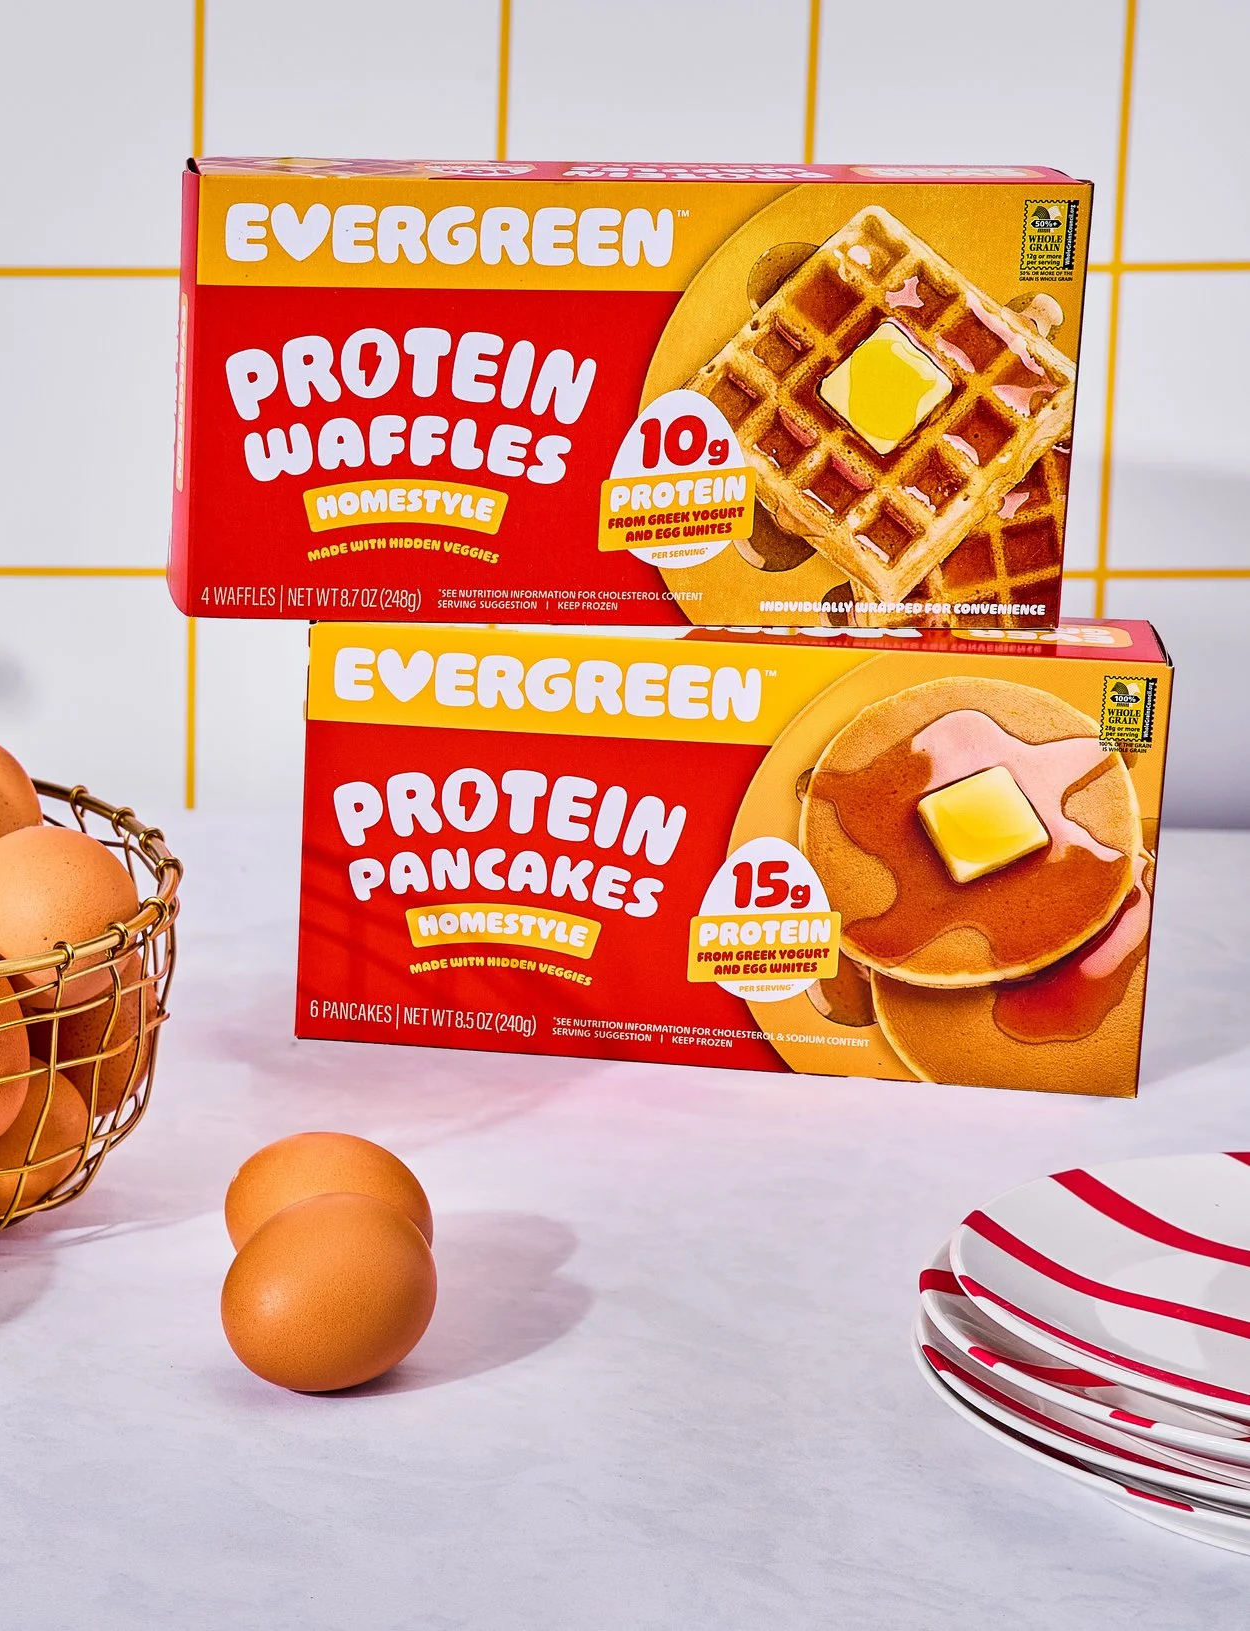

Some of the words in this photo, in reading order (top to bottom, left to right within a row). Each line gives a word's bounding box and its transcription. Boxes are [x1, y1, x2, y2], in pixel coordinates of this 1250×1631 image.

[226, 203, 673, 266] EVERGREEN
[1028, 235, 1063, 243] WHOLE
[225, 327, 597, 425] PROTEIN
[244, 414, 572, 484] WAFFLES
[640, 415, 730, 469] 10g
[317, 489, 495, 521] HOMESTYLE
[610, 475, 746, 512] PROTEIN
[608, 516, 645, 529] FROM
[648, 512, 689, 525] GREEK
[692, 507, 744, 521] YOGURT
[626, 530, 652, 542] AND
[656, 527, 680, 539] EGG
[682, 522, 732, 537] WHITES
[308, 543, 348, 561] MADE
[350, 538, 386, 551] WITH
[390, 538, 440, 550] HIDDEN
[444, 542, 499, 563] VEGGIES
[651, 550, 668, 559] PER
[201, 587, 209, 604] 4
[214, 587, 275, 606] WAFFLES
[288, 588, 313, 606] NET
[316, 588, 339, 606] WT
[341, 589, 359, 607] 8.7
[361, 589, 377, 607] OZ
[380, 588, 421, 612] (248g)
[438, 600, 476, 608] SERVING
[480, 601, 537, 609] SUGGESTION
[582, 602, 617, 610] FROZEN
[459, 590, 508, 598] NUTRITION
[511, 590, 576, 599] INFORMATION
[578, 591, 596, 599] FOR
[598, 591, 659, 600] CHOLESTEROL
[662, 591, 703, 601] CONTENT
[759, 601, 853, 613] INDIVIDUALLY
[855, 602, 922, 614] WRAPPED
[924, 603, 952, 614] FOR
[953, 603, 1046, 616] CONVENIENCE
[335, 648, 761, 722] EVERGREEN
[1107, 708, 1142, 717] WHOLE
[1108, 716, 1139, 724] GRAIN
[333, 767, 687, 866] PROTEIN
[348, 847, 664, 918] PANCAKES
[733, 861, 811, 909] 15g
[418, 912, 588, 947] HOMESTYLE
[699, 919, 831, 947] PROTEIN
[698, 952, 733, 962] FROM
[736, 950, 776, 960] GREEK
[779, 949, 829, 959] YOGURT
[714, 965, 740, 974] AND
[743, 964, 767, 974] EGG
[770, 962, 817, 973] WHITES
[410, 959, 448, 974] MADE
[450, 957, 484, 967] WITH
[487, 957, 536, 970] HIDDEN
[539, 963, 592, 986] VEGGIES
[310, 1000, 318, 1017] 6
[323, 1001, 391, 1023] PANCAKES
[404, 1007, 429, 1025] NET
[432, 1009, 454, 1027] WT
[455, 1011, 474, 1029] 8.5
[477, 1012, 493, 1030] OZ
[495, 1013, 536, 1037] (240g)
[552, 1028, 591, 1038] SERVING
[594, 1030, 652, 1042] SUGGESTION
[672, 1036, 694, 1045] KEEP
[696, 1037, 732, 1048] FROZEN
[573, 1018, 623, 1030] NUTRITION
[624, 1022, 691, 1034] INFORMATION
[692, 1027, 710, 1036] FOR
[712, 1028, 774, 1040] CHOLESTEROL
[776, 1032, 784, 1041] &
[786, 1034, 825, 1044] SODIUM
[826, 1037, 870, 1048] CONTENT
